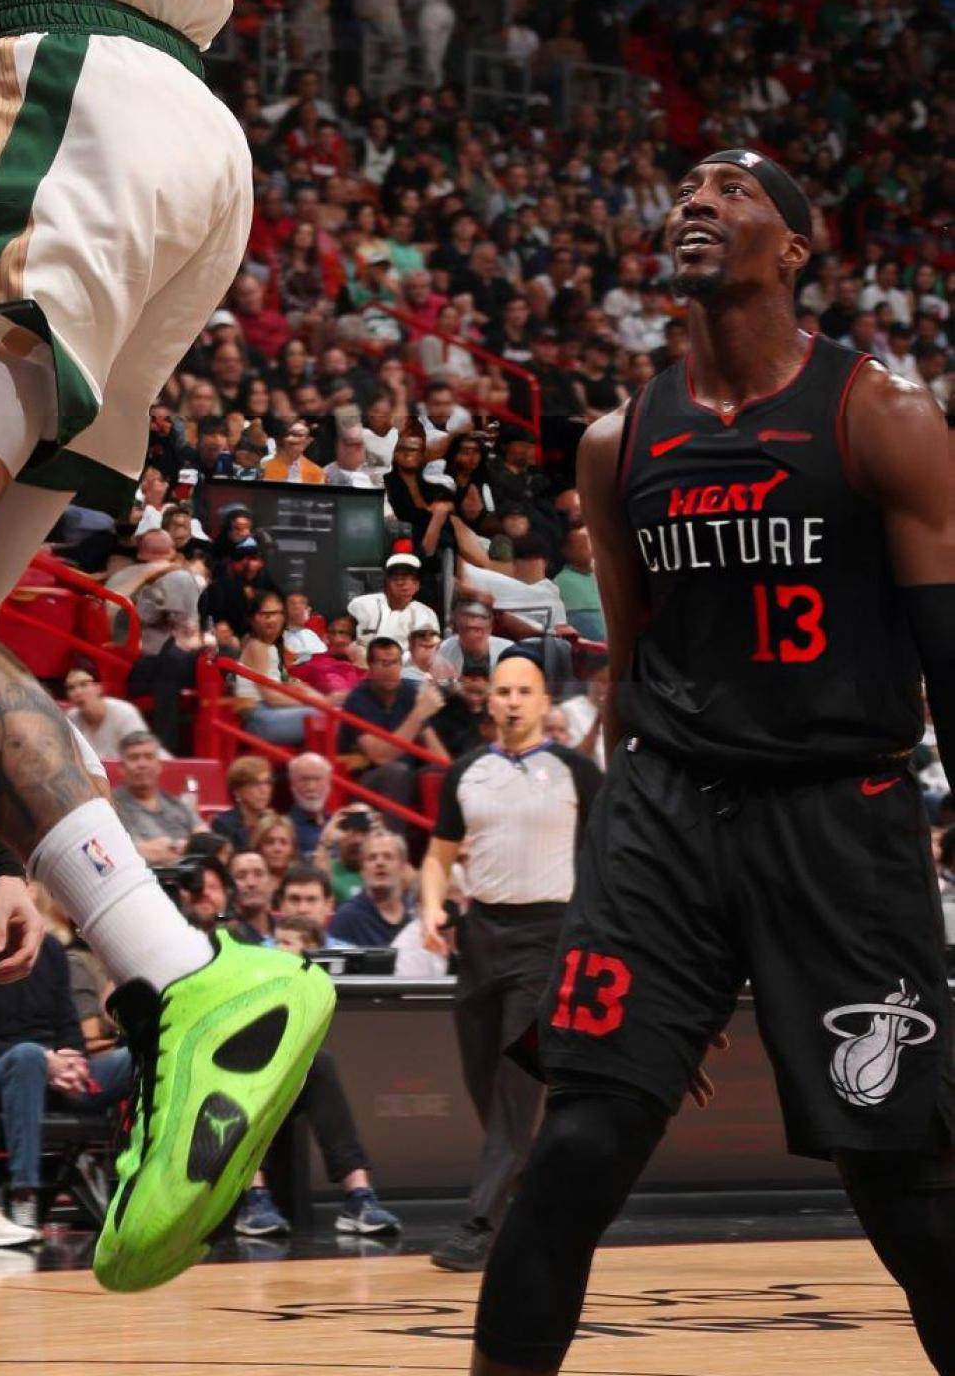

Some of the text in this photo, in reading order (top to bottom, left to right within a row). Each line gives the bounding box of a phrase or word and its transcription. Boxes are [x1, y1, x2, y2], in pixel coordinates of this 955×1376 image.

[668, 470, 790, 517] HEAT
[637, 516, 825, 572] CULTURE
[750, 583, 828, 663] 13
[550, 948, 634, 1037] 13
